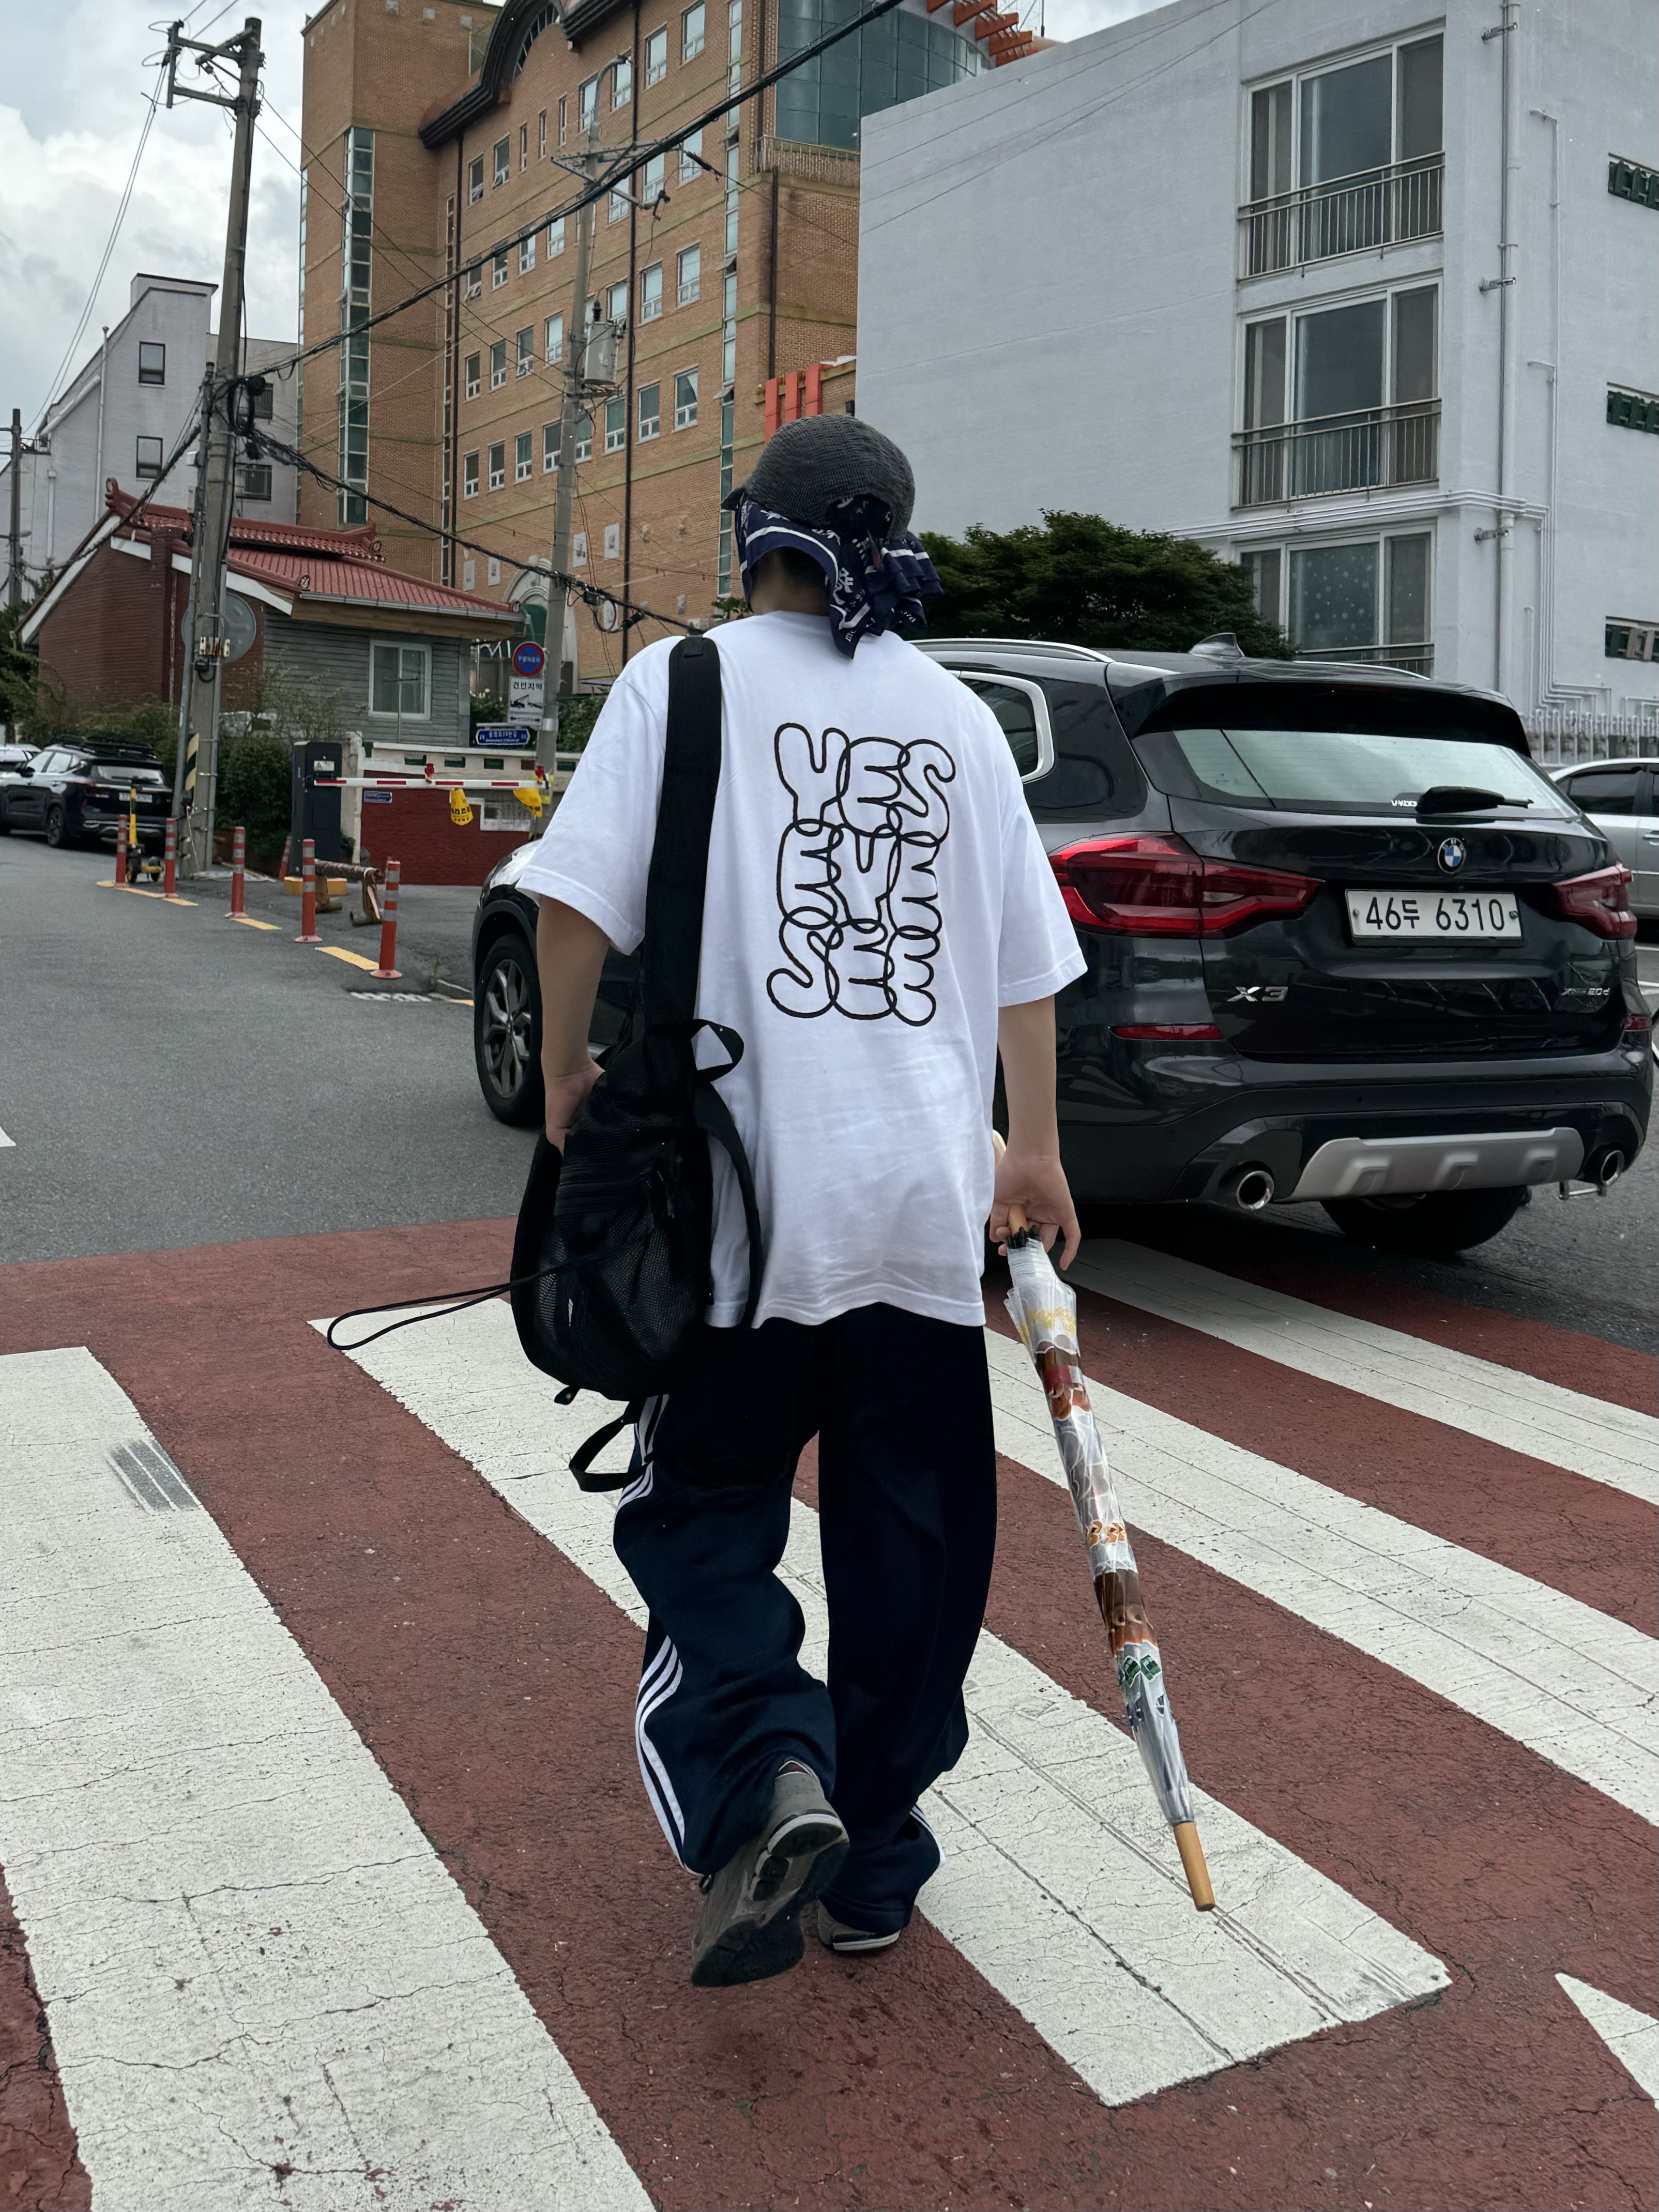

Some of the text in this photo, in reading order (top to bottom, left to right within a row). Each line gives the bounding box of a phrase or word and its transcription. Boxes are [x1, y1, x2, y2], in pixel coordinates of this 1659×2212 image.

[774, 722, 955, 847] YES
[777, 818, 942, 940] EYE
[1365, 896, 1505, 931] 46두 6310
[766, 906, 940, 1027] SEE
[1227, 986, 1289, 1002] X3
